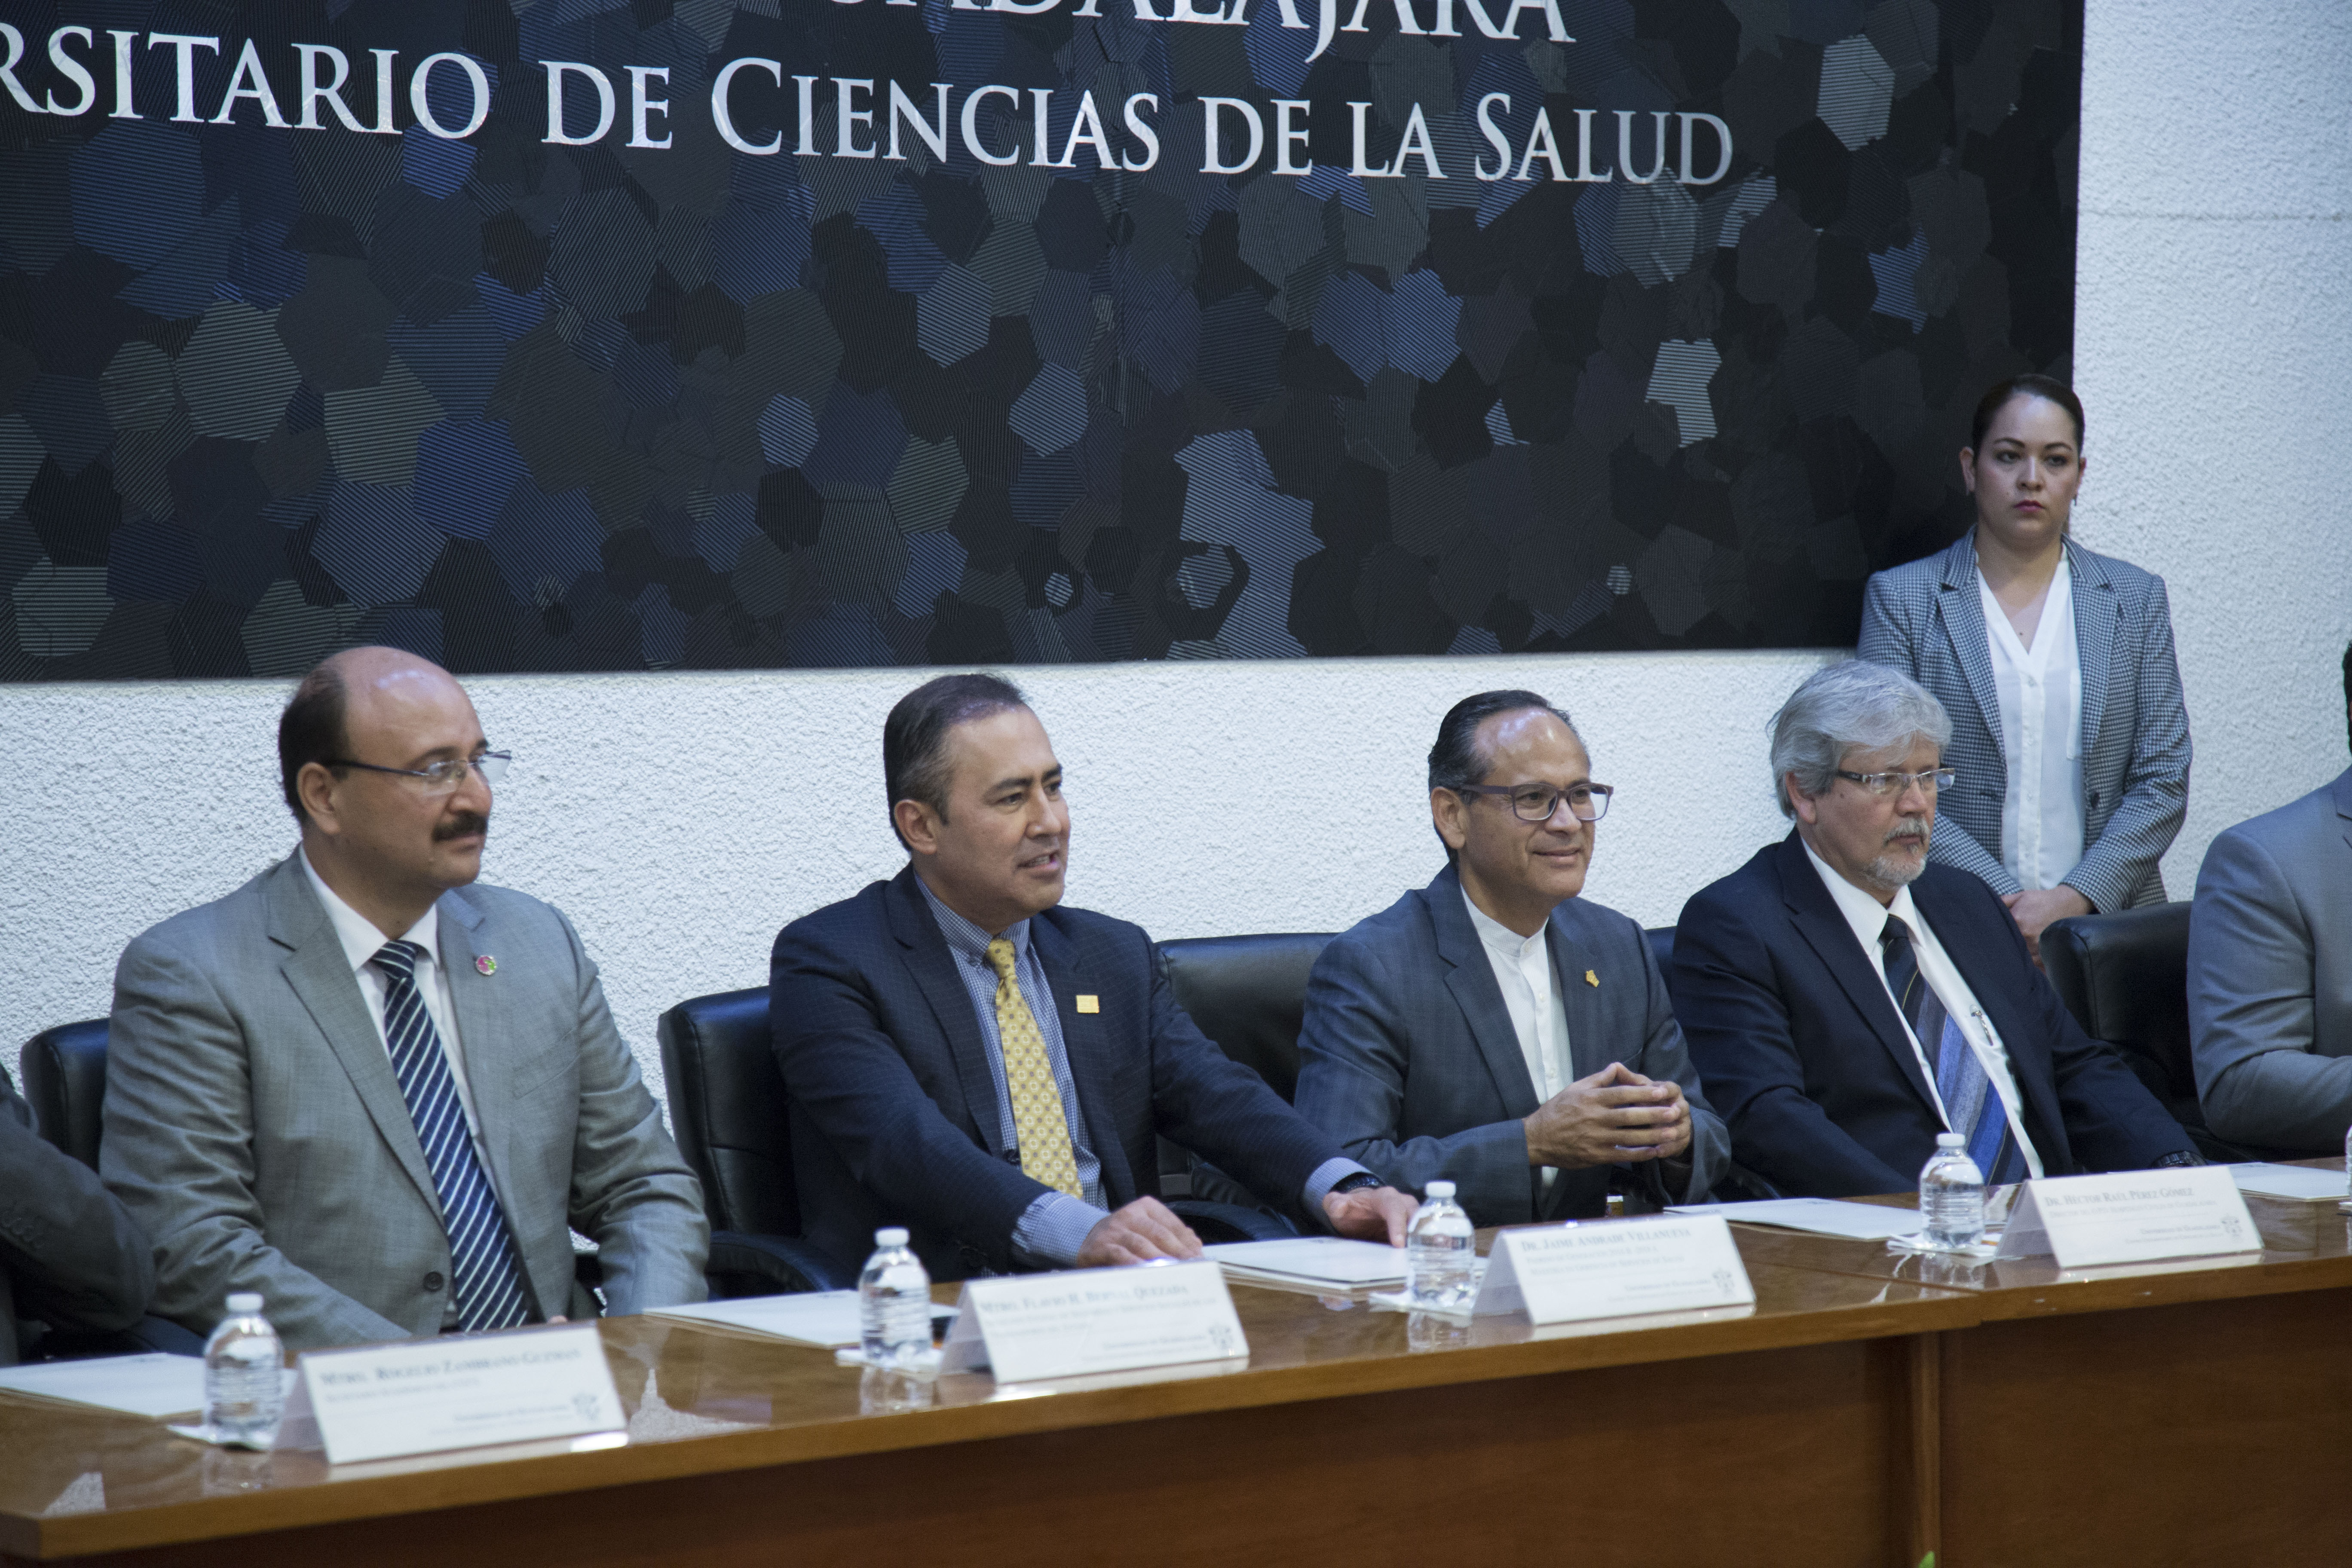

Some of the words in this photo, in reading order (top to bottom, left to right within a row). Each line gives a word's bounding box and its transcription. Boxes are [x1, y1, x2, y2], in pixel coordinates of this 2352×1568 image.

[0, 22, 490, 140] RSITARIO
[539, 60, 673, 150] DE
[710, 57, 1161, 172] CIENCIAS
[1197, 96, 1313, 176] DE
[1347, 101, 1448, 179] LA
[1474, 92, 1732, 186] SALUD
[2044, 1196, 2062, 1207] DR.
[1521, 1240, 1541, 1253] DR.
[1543, 1237, 1574, 1250] JAIME
[1577, 1233, 1625, 1247] ANDRADE
[1626, 1228, 1691, 1242] VILLANUEVA
